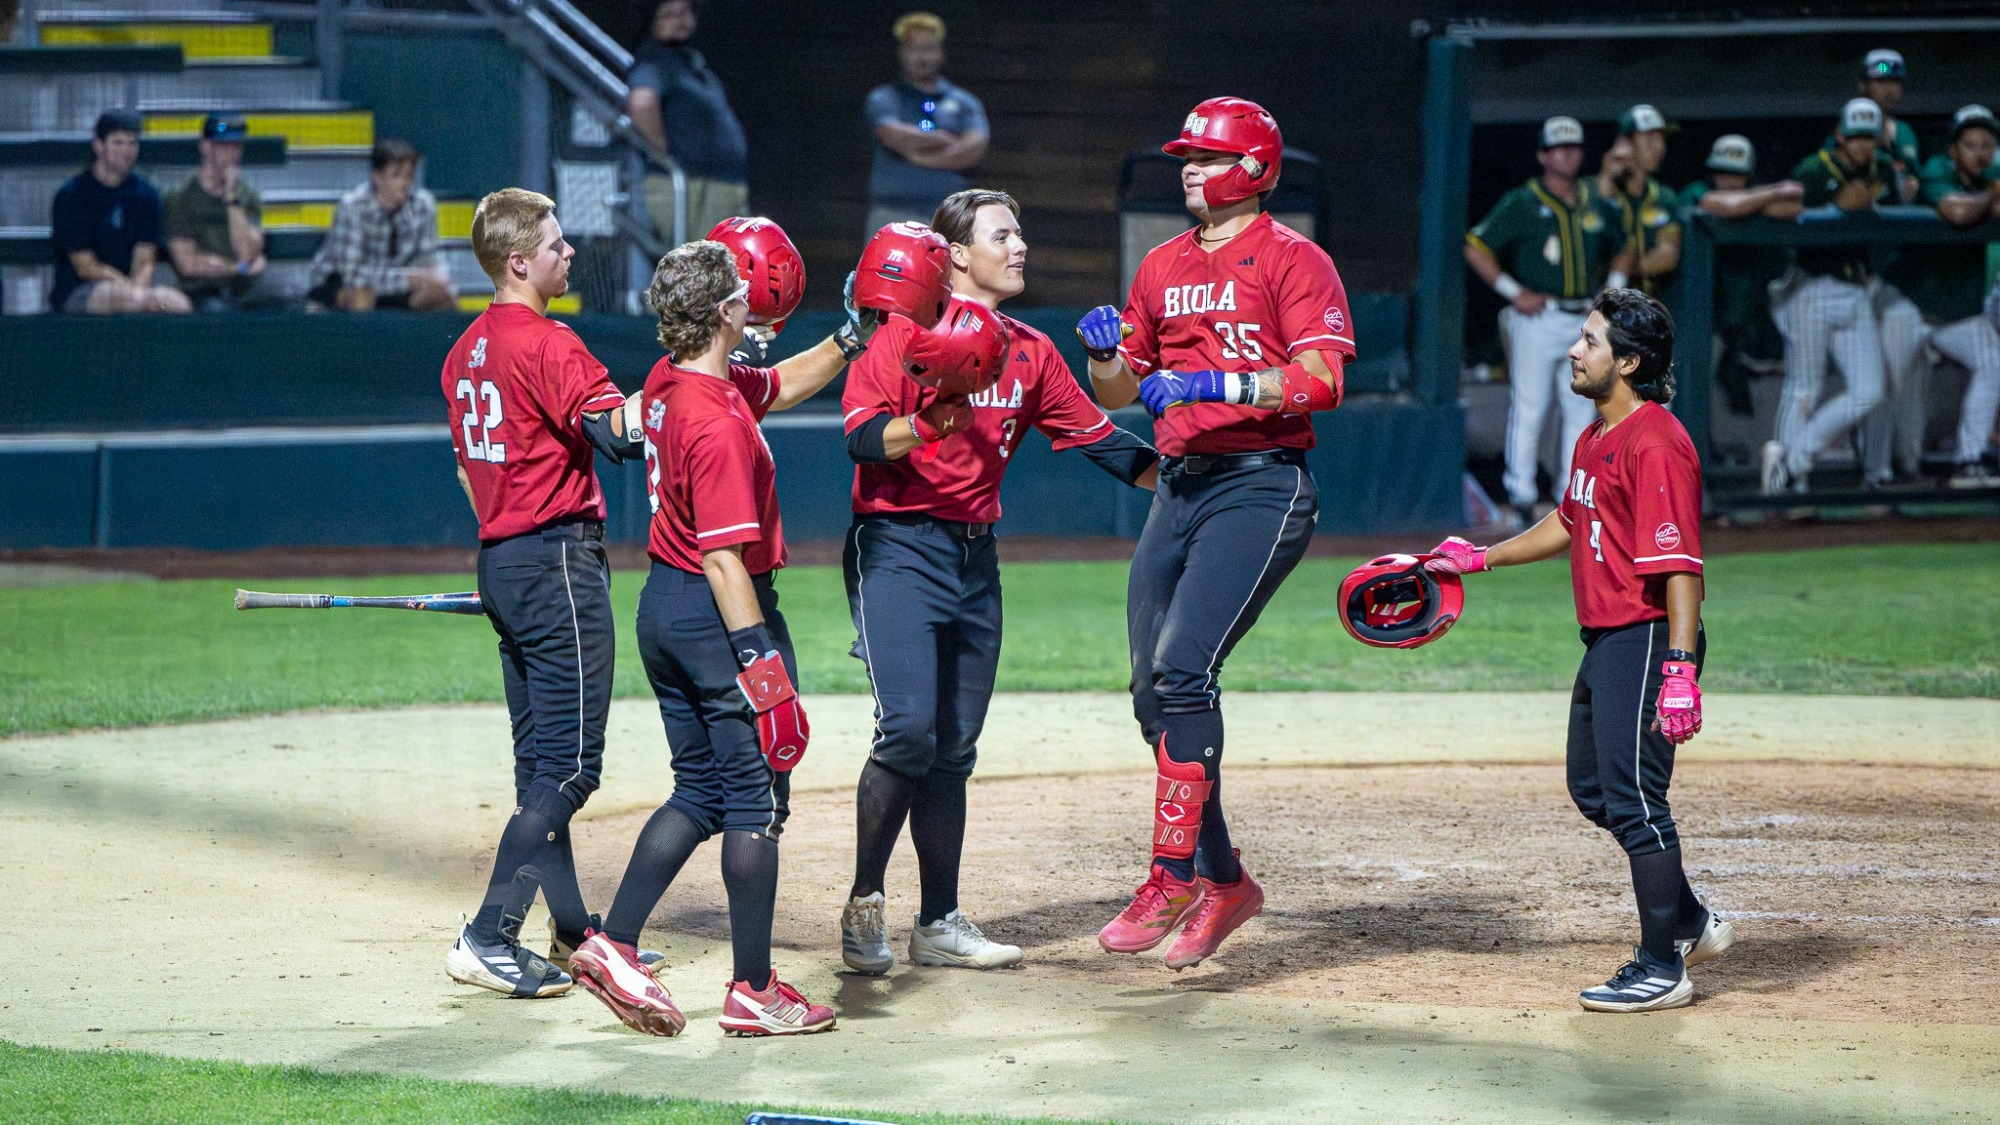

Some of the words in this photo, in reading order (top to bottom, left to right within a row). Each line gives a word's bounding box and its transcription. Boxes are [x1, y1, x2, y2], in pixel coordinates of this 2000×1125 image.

[1164, 280, 1237, 318] BIOLA
[1214, 321, 1262, 361] 35
[968, 378, 1023, 408] OLA
[456, 379, 506, 463] 22
[999, 418, 1017, 458] 3
[1589, 520, 1604, 562] 4
